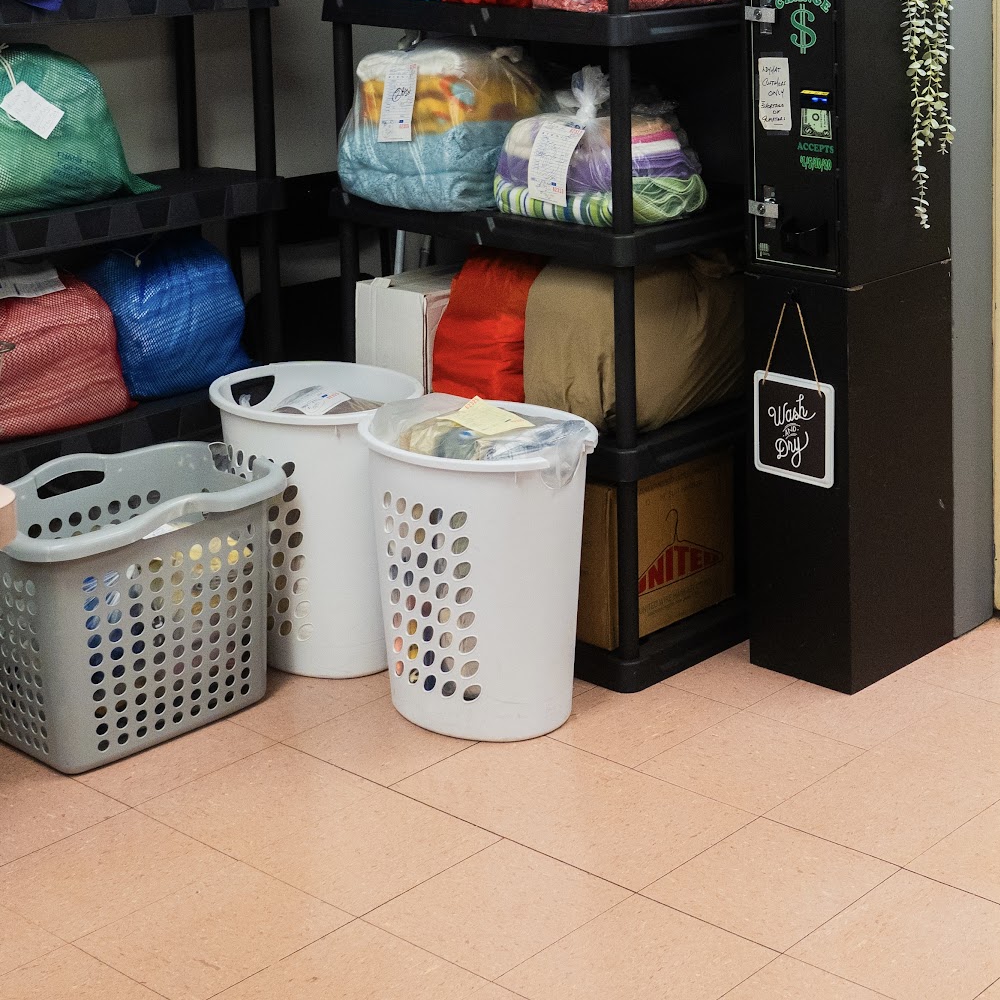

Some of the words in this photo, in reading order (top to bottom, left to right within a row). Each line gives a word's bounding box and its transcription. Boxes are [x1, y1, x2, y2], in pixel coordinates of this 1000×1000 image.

[797, 142, 834, 154] ACCEPTS
[768, 394, 816, 426] Wash
[785, 426, 798, 436] AND
[775, 431, 809, 467] Dry
